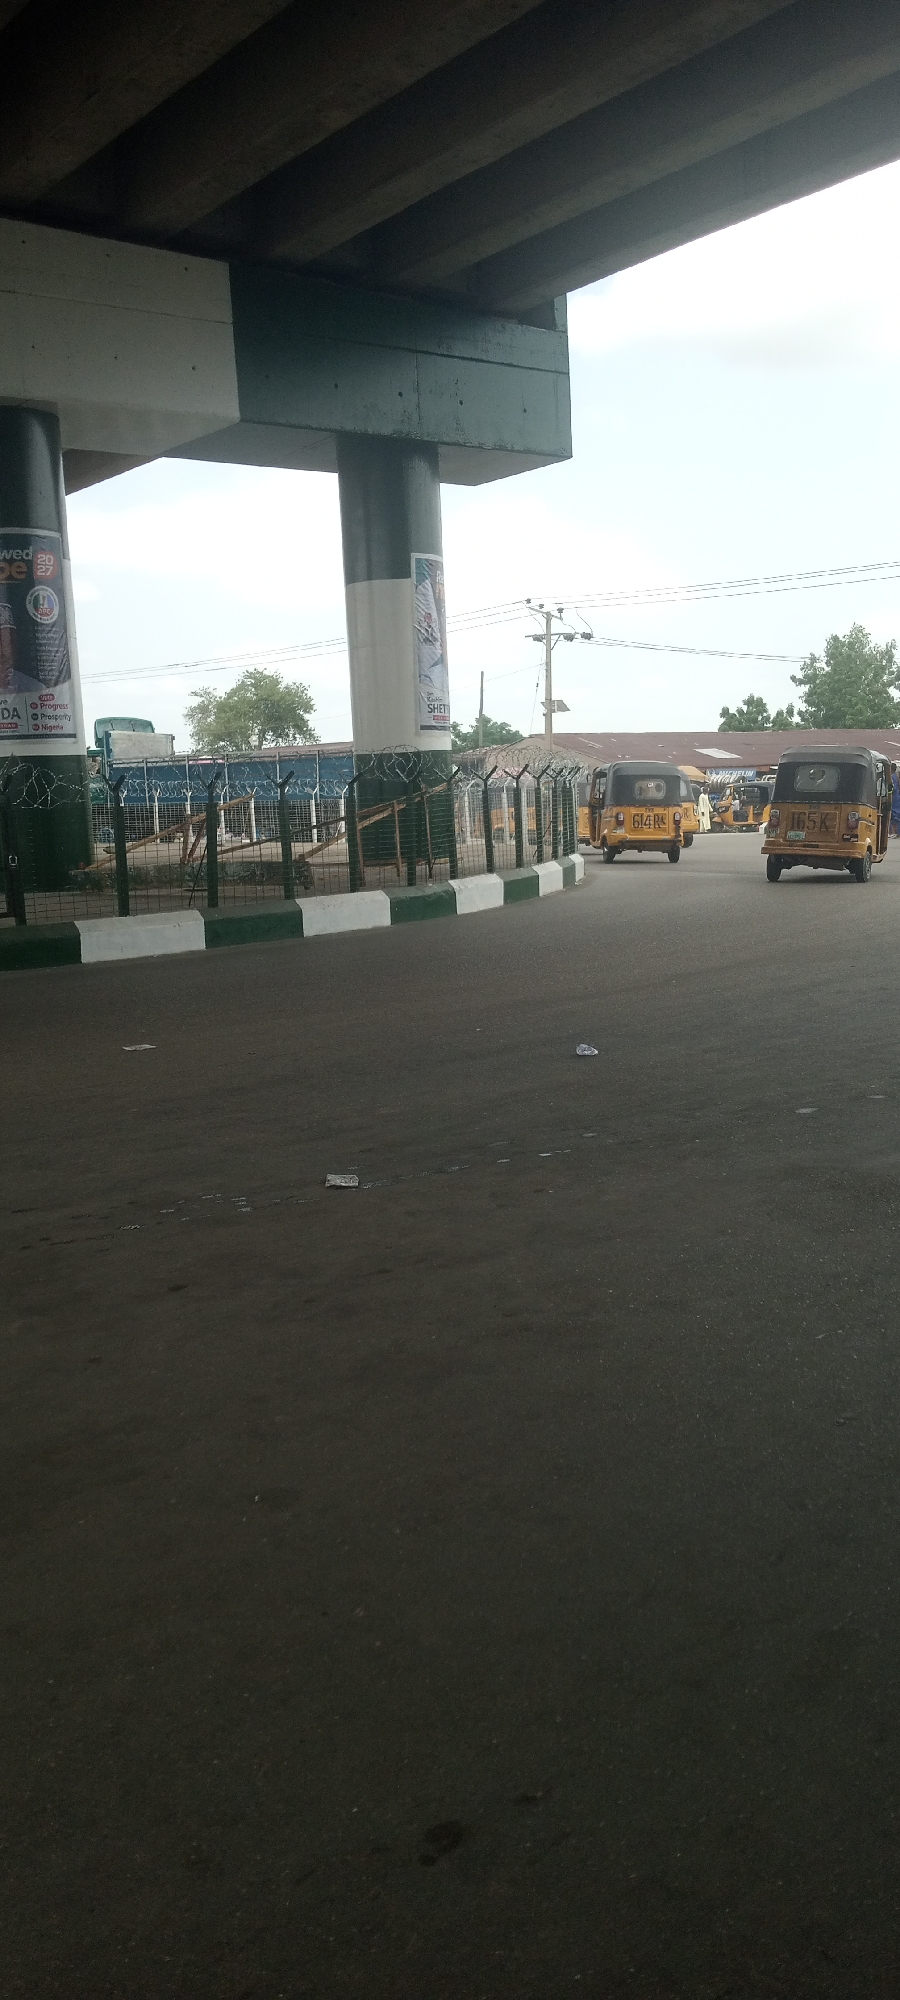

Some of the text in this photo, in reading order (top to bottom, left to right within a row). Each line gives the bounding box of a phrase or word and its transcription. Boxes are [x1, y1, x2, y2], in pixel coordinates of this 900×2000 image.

[37, 554, 54, 565] 20
[37, 565, 54, 576] 27
[40, 702, 69, 711] Progress
[1, 707, 22, 720] DA
[40, 712, 72, 722] Prosperity
[41, 723, 64, 732] Nigeria
